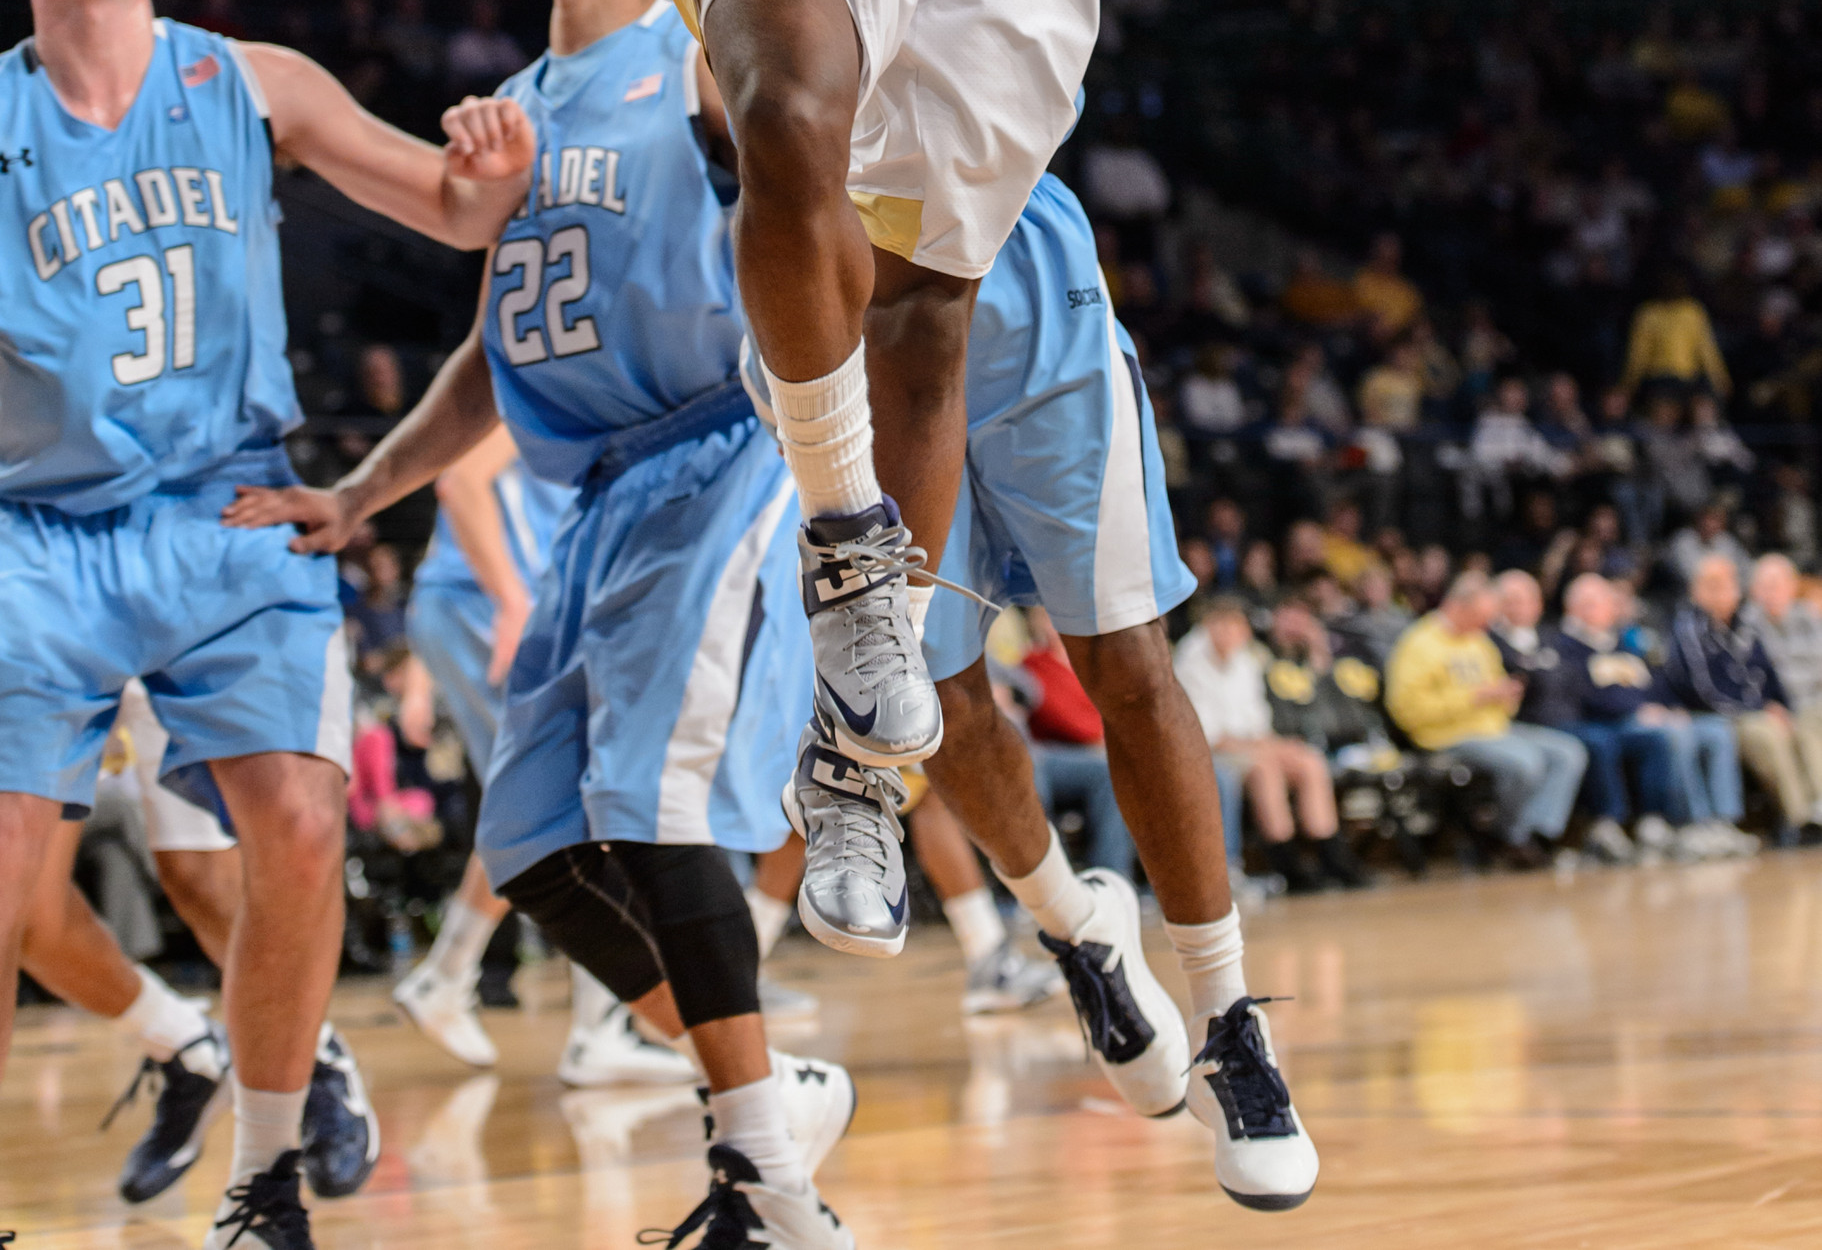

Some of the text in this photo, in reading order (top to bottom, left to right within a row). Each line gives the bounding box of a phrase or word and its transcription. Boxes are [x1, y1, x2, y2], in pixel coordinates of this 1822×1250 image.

[27, 166, 239, 282] CITADEL
[514, 146, 626, 220] ADEL
[95, 243, 197, 387] 31
[494, 223, 603, 367] 22
